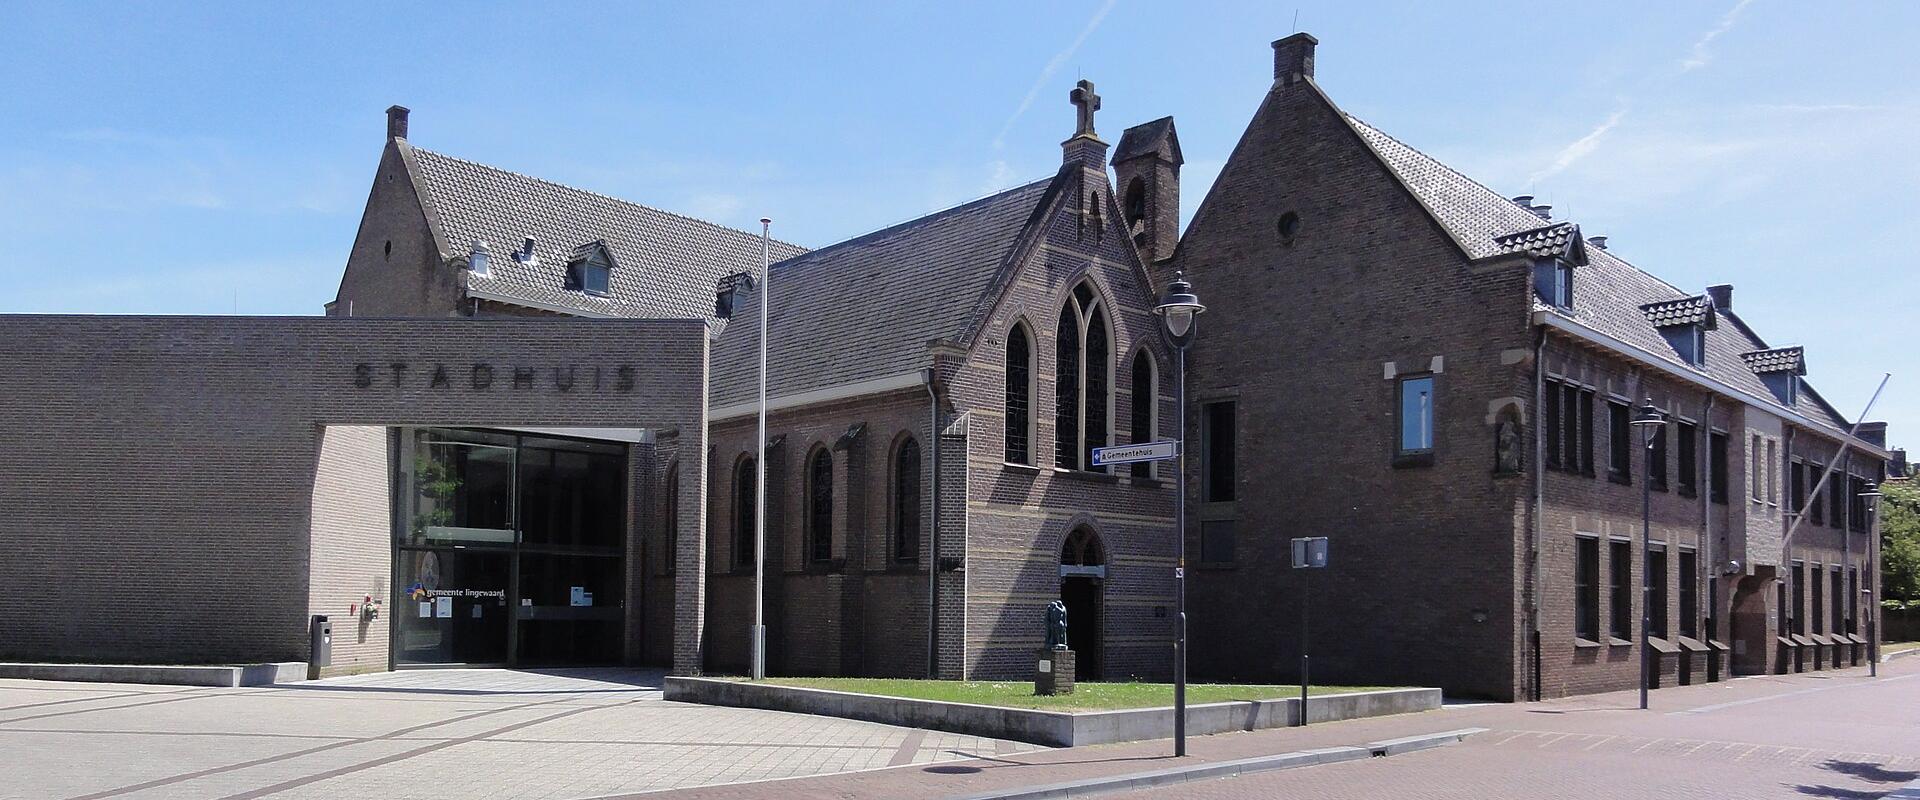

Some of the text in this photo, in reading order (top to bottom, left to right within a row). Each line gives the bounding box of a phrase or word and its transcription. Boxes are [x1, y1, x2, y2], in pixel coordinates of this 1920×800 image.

[354, 362, 636, 392] STADHUIS
[1106, 449, 1153, 459] Gemeentehuis
[426, 588, 504, 598] gemeente lingewaard
